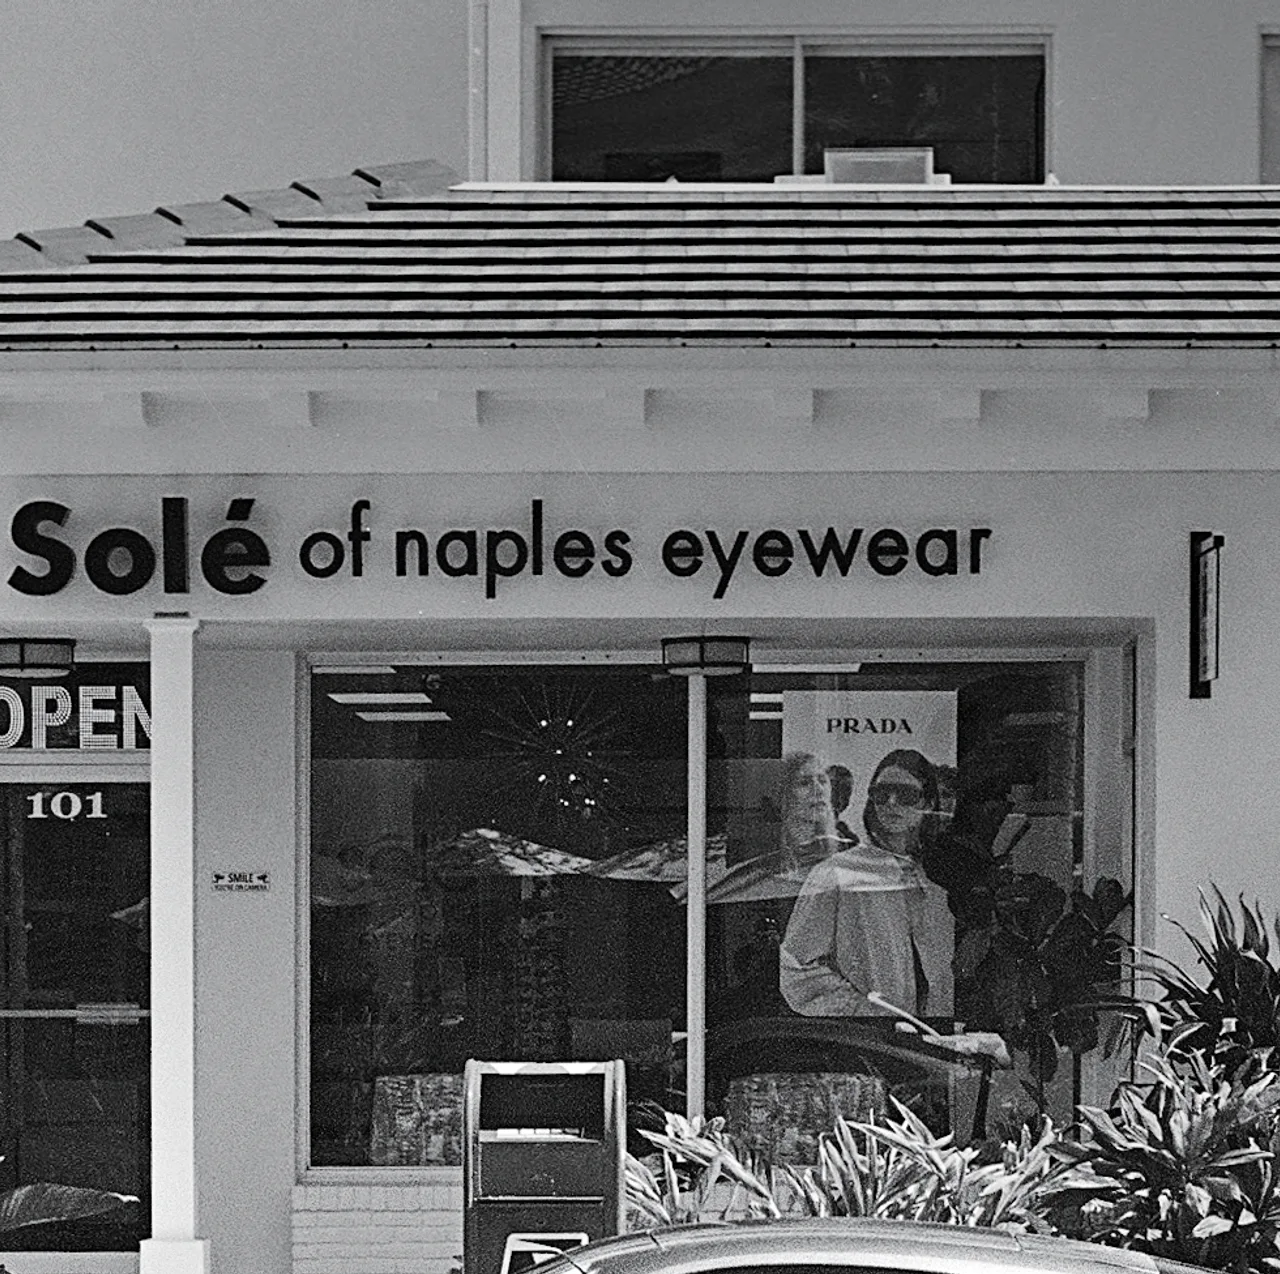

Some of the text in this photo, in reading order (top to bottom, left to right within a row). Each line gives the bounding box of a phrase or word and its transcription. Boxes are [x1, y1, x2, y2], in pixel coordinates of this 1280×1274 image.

[8, 497, 992, 599] Solé of naples eyewear
[827, 717, 912, 735] PRADA
[27, 792, 107, 820] 101
